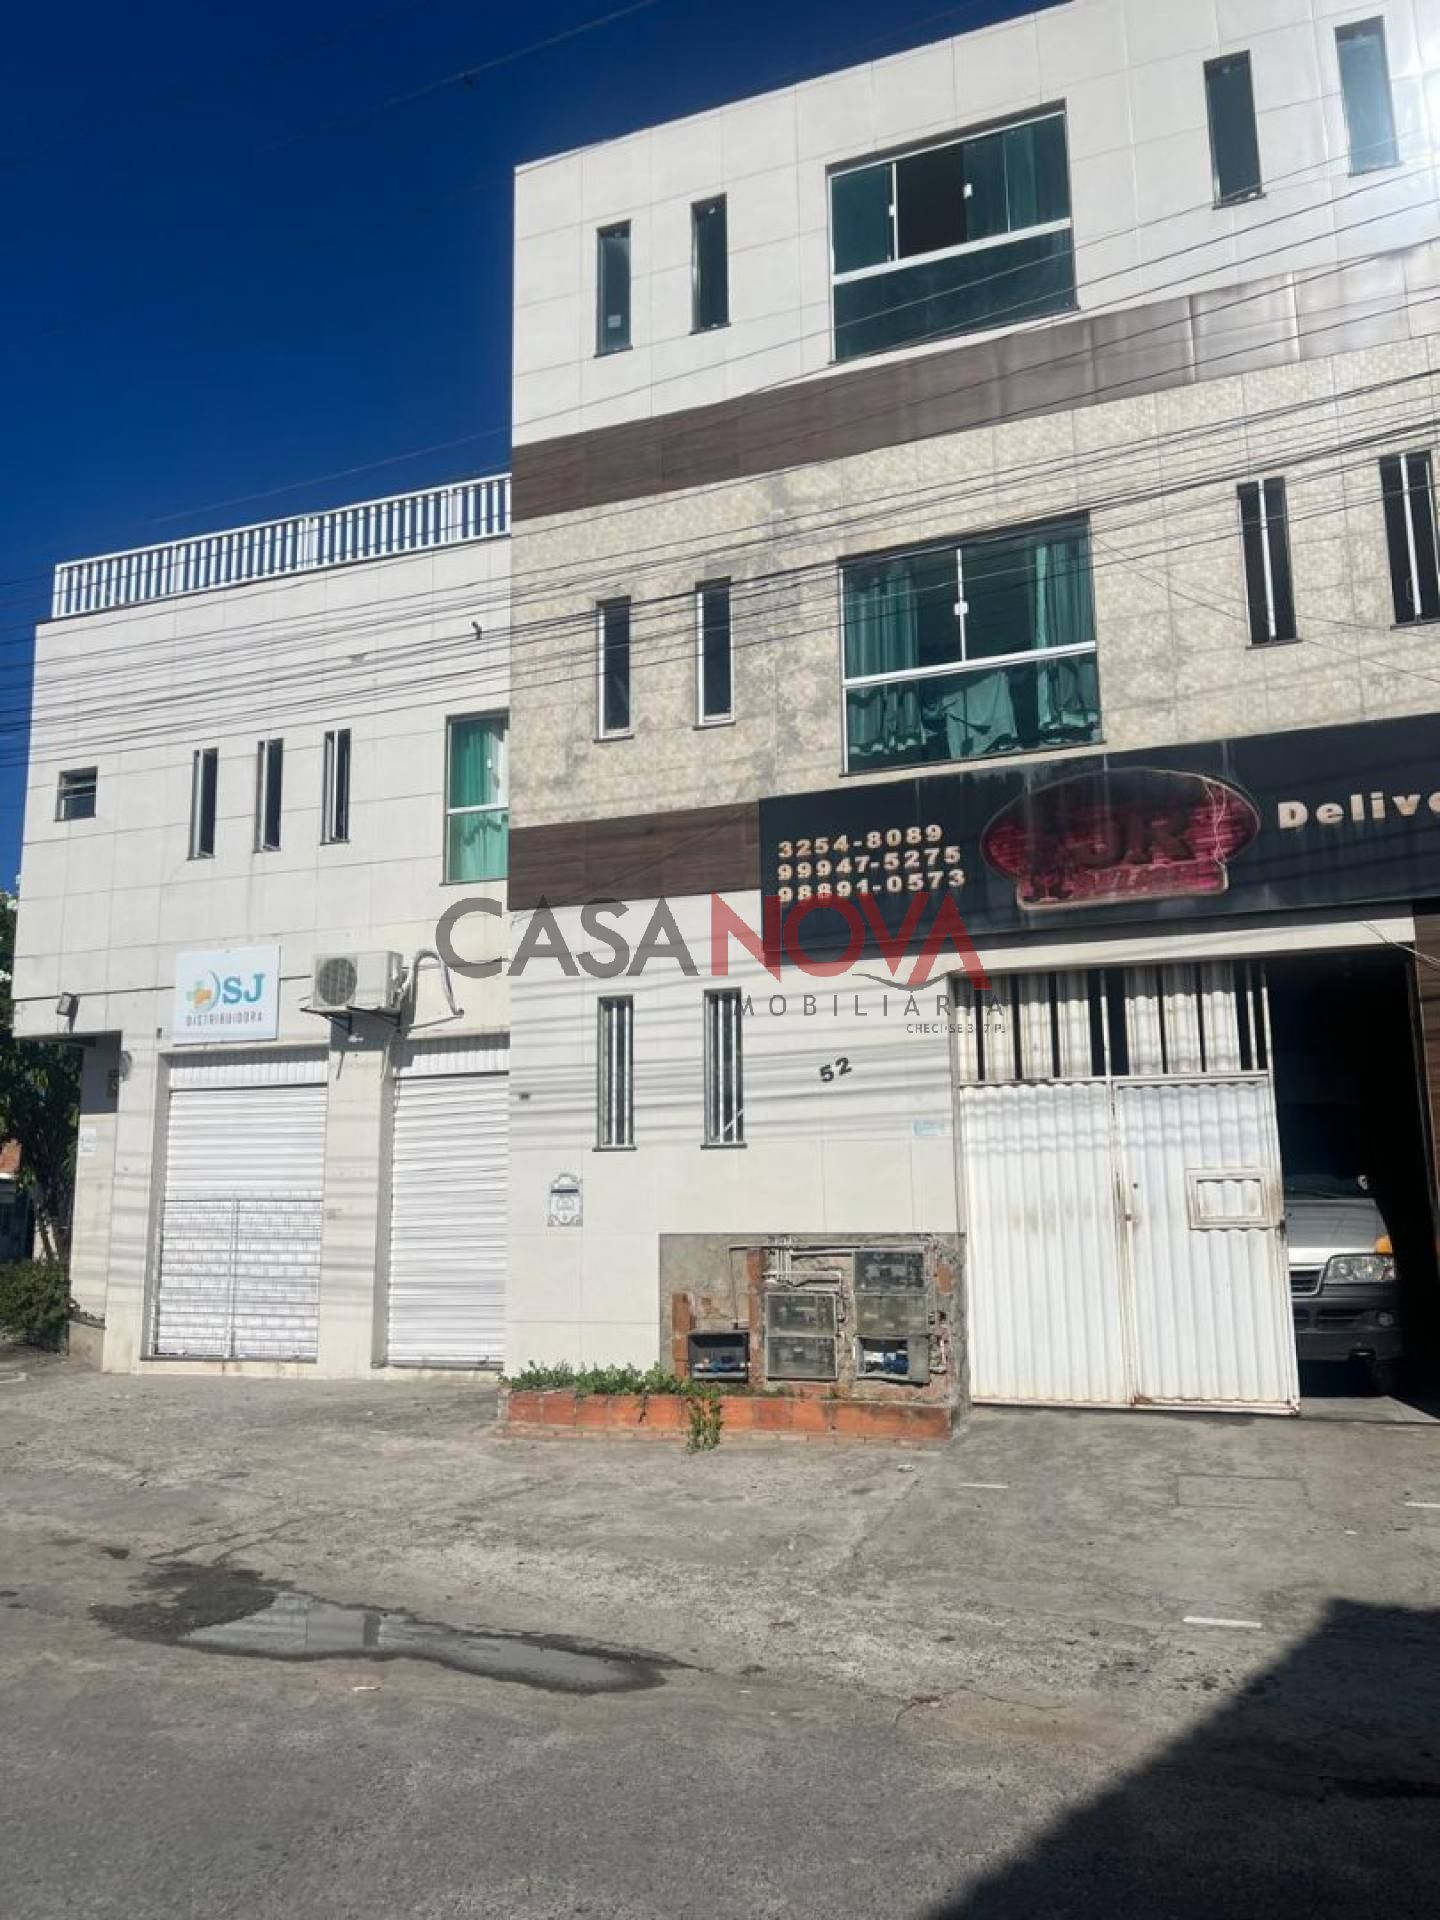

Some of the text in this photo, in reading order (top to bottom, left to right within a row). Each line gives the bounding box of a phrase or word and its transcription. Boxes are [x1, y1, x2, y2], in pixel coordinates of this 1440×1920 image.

[778, 824, 943, 858] 3254-8089
[777, 845, 961, 881] 99947-5275
[777, 868, 966, 903] 98891-0573
[223, 972, 266, 1005] SJ
[819, 1057, 852, 1083] 52
